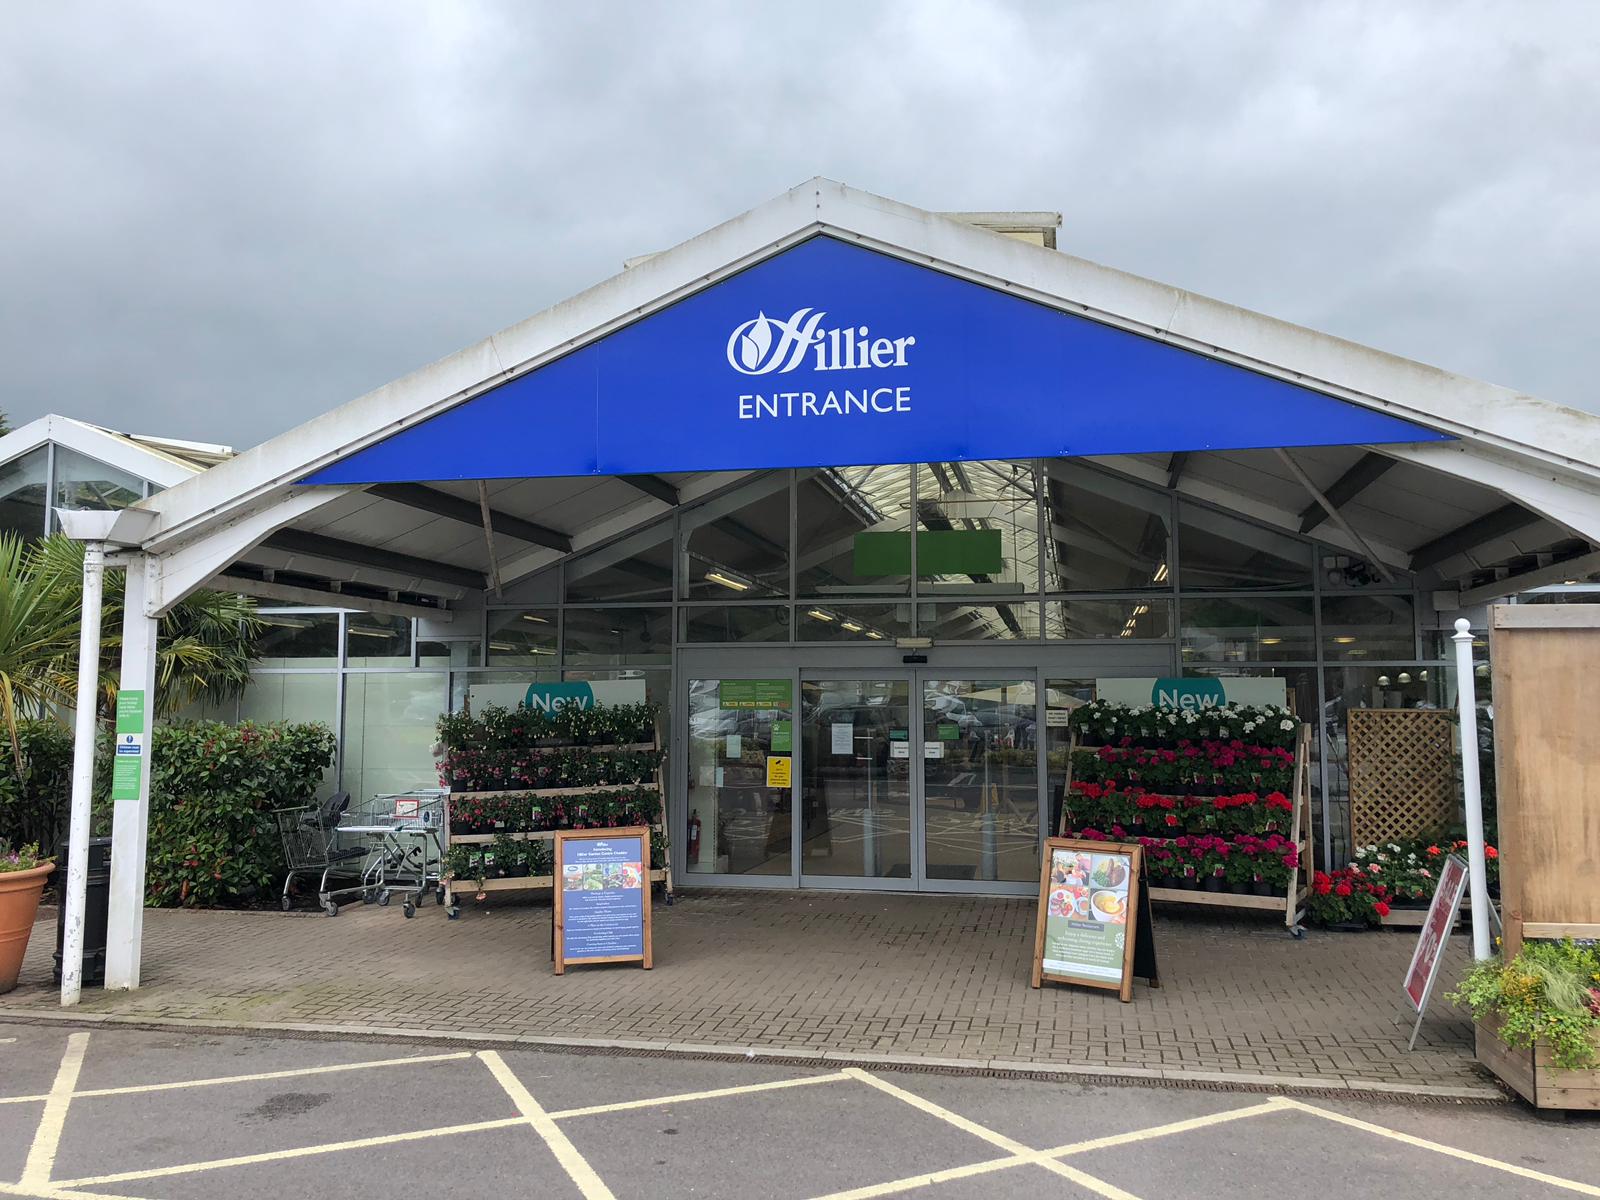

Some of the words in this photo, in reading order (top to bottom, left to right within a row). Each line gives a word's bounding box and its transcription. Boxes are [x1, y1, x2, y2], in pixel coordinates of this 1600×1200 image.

[727, 307, 915, 375] Hillier
[739, 387, 911, 419] ENTRANCE
[532, 693, 588, 712] New
[1159, 689, 1219, 710] New
